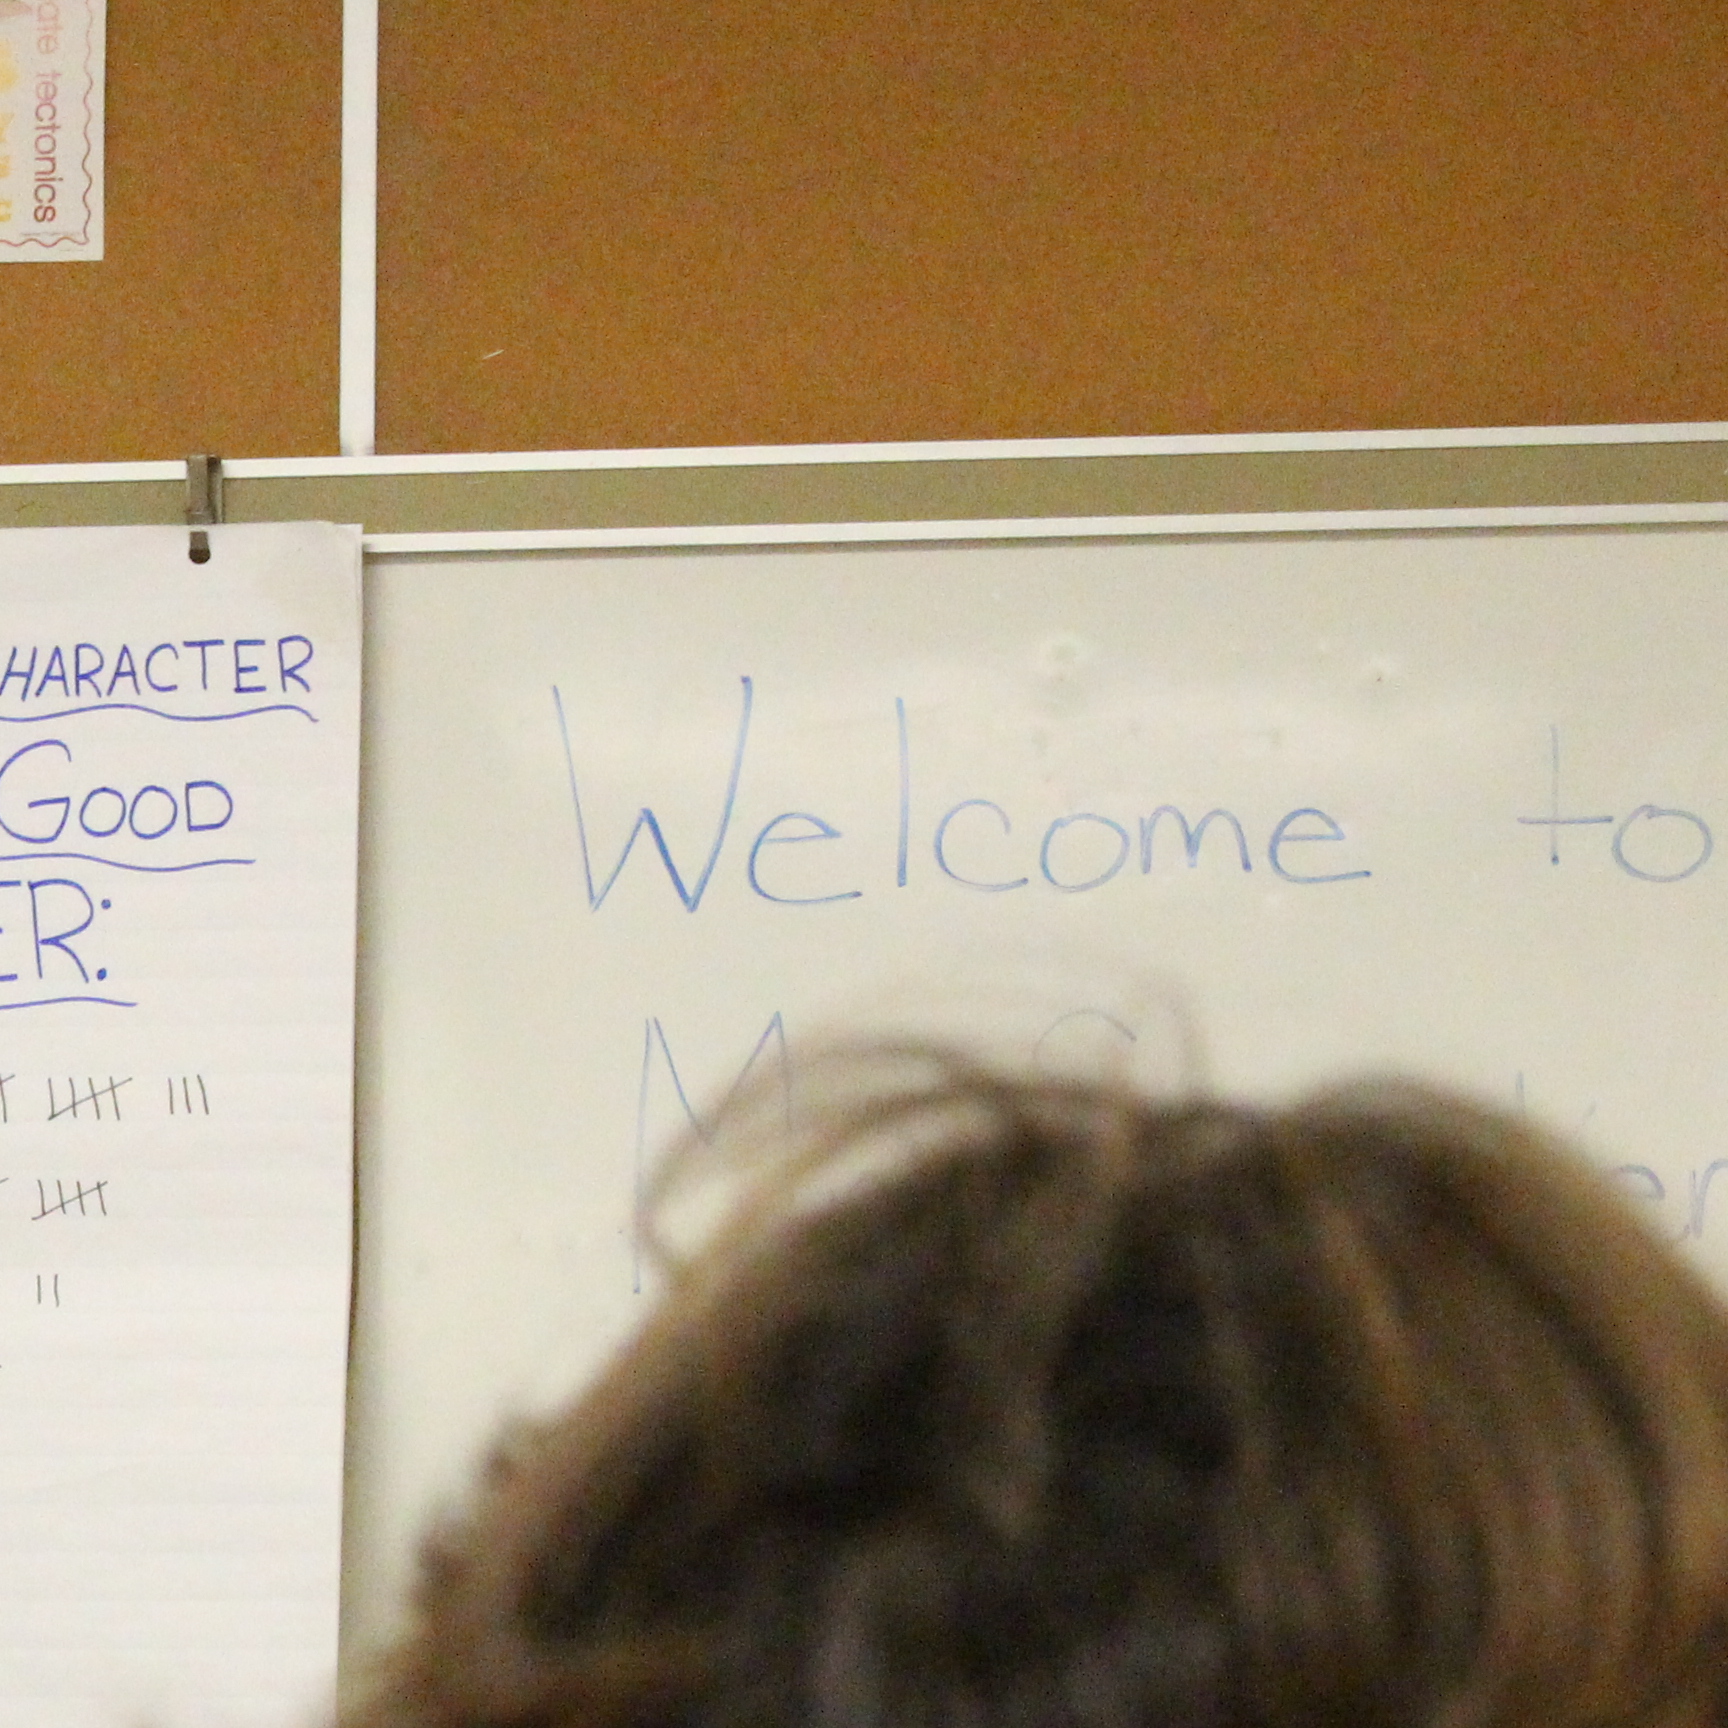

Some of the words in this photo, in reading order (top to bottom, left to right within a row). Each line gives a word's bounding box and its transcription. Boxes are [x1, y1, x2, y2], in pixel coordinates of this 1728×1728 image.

[32, 70, 64, 223] tectonics
[550, 675, 1372, 914] Welcome
[1516, 723, 1714, 885] to
